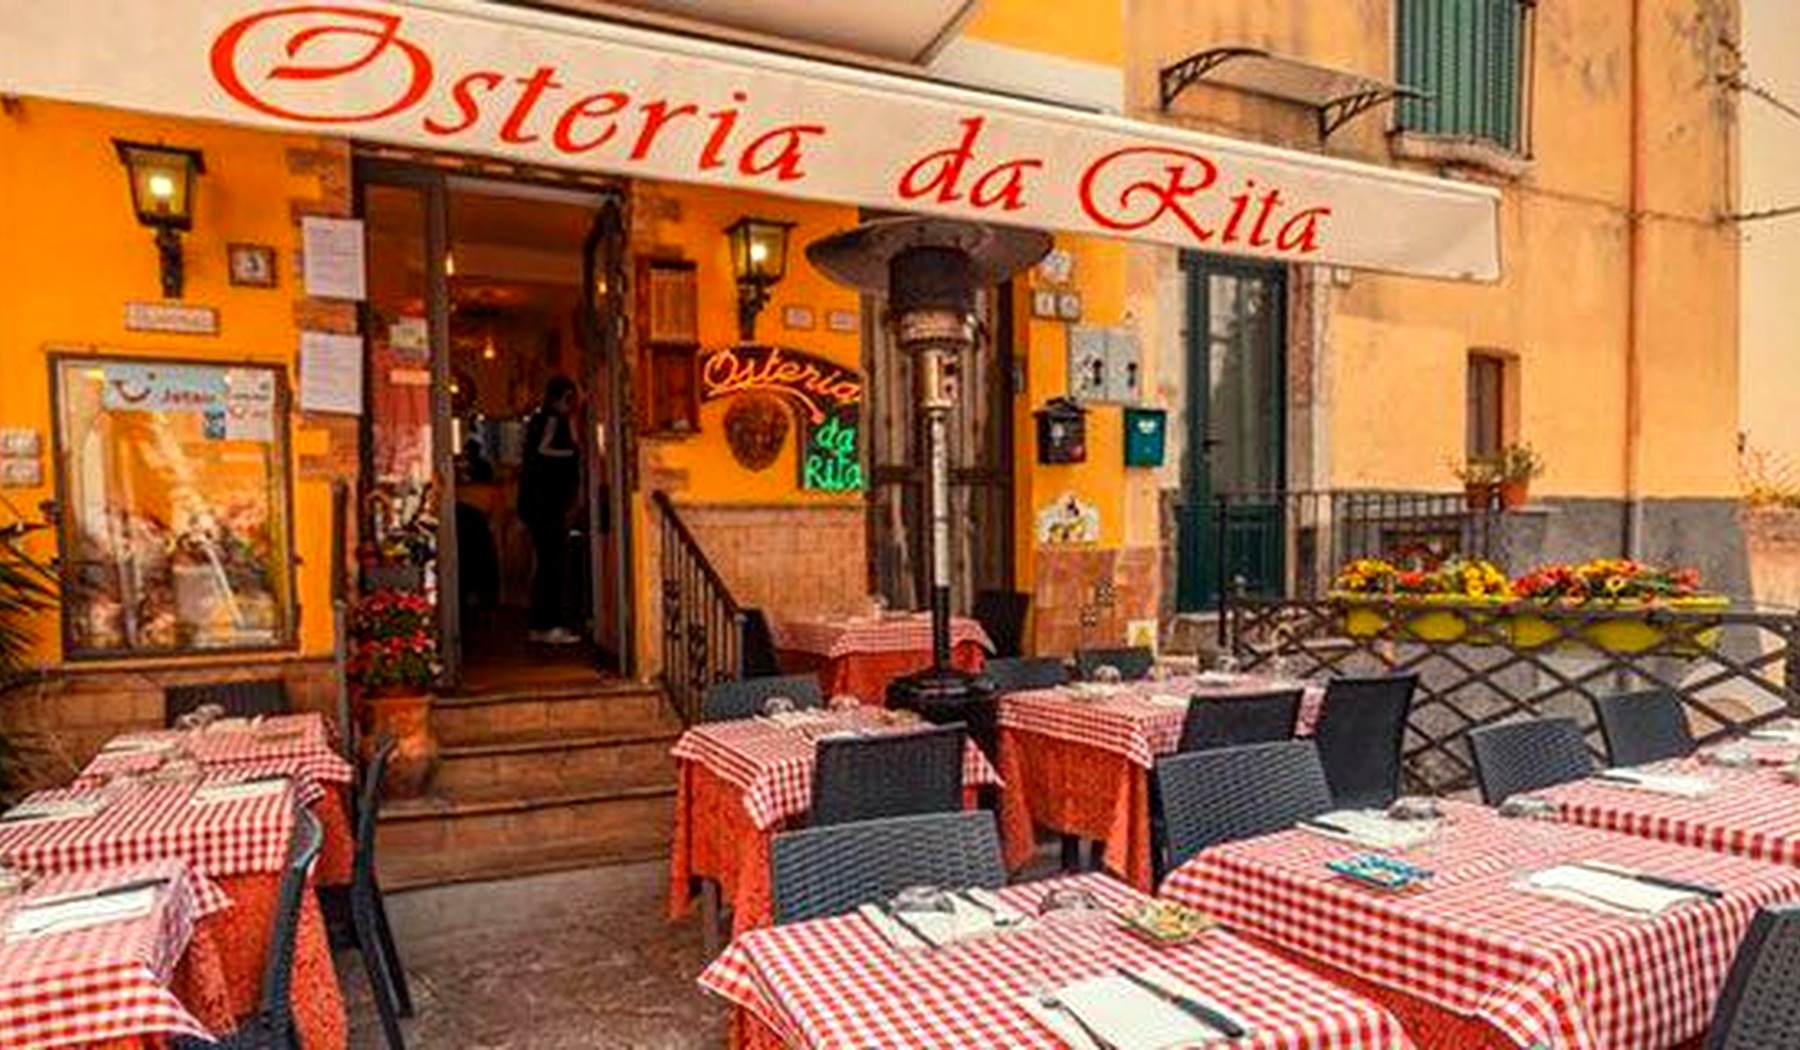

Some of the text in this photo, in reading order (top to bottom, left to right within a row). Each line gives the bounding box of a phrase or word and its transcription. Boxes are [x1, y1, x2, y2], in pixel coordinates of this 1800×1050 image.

[209, 5, 1332, 254] Osteria da Rita
[703, 346, 861, 403] Osteria
[816, 416, 856, 453] da
[804, 454, 862, 492] Rita
